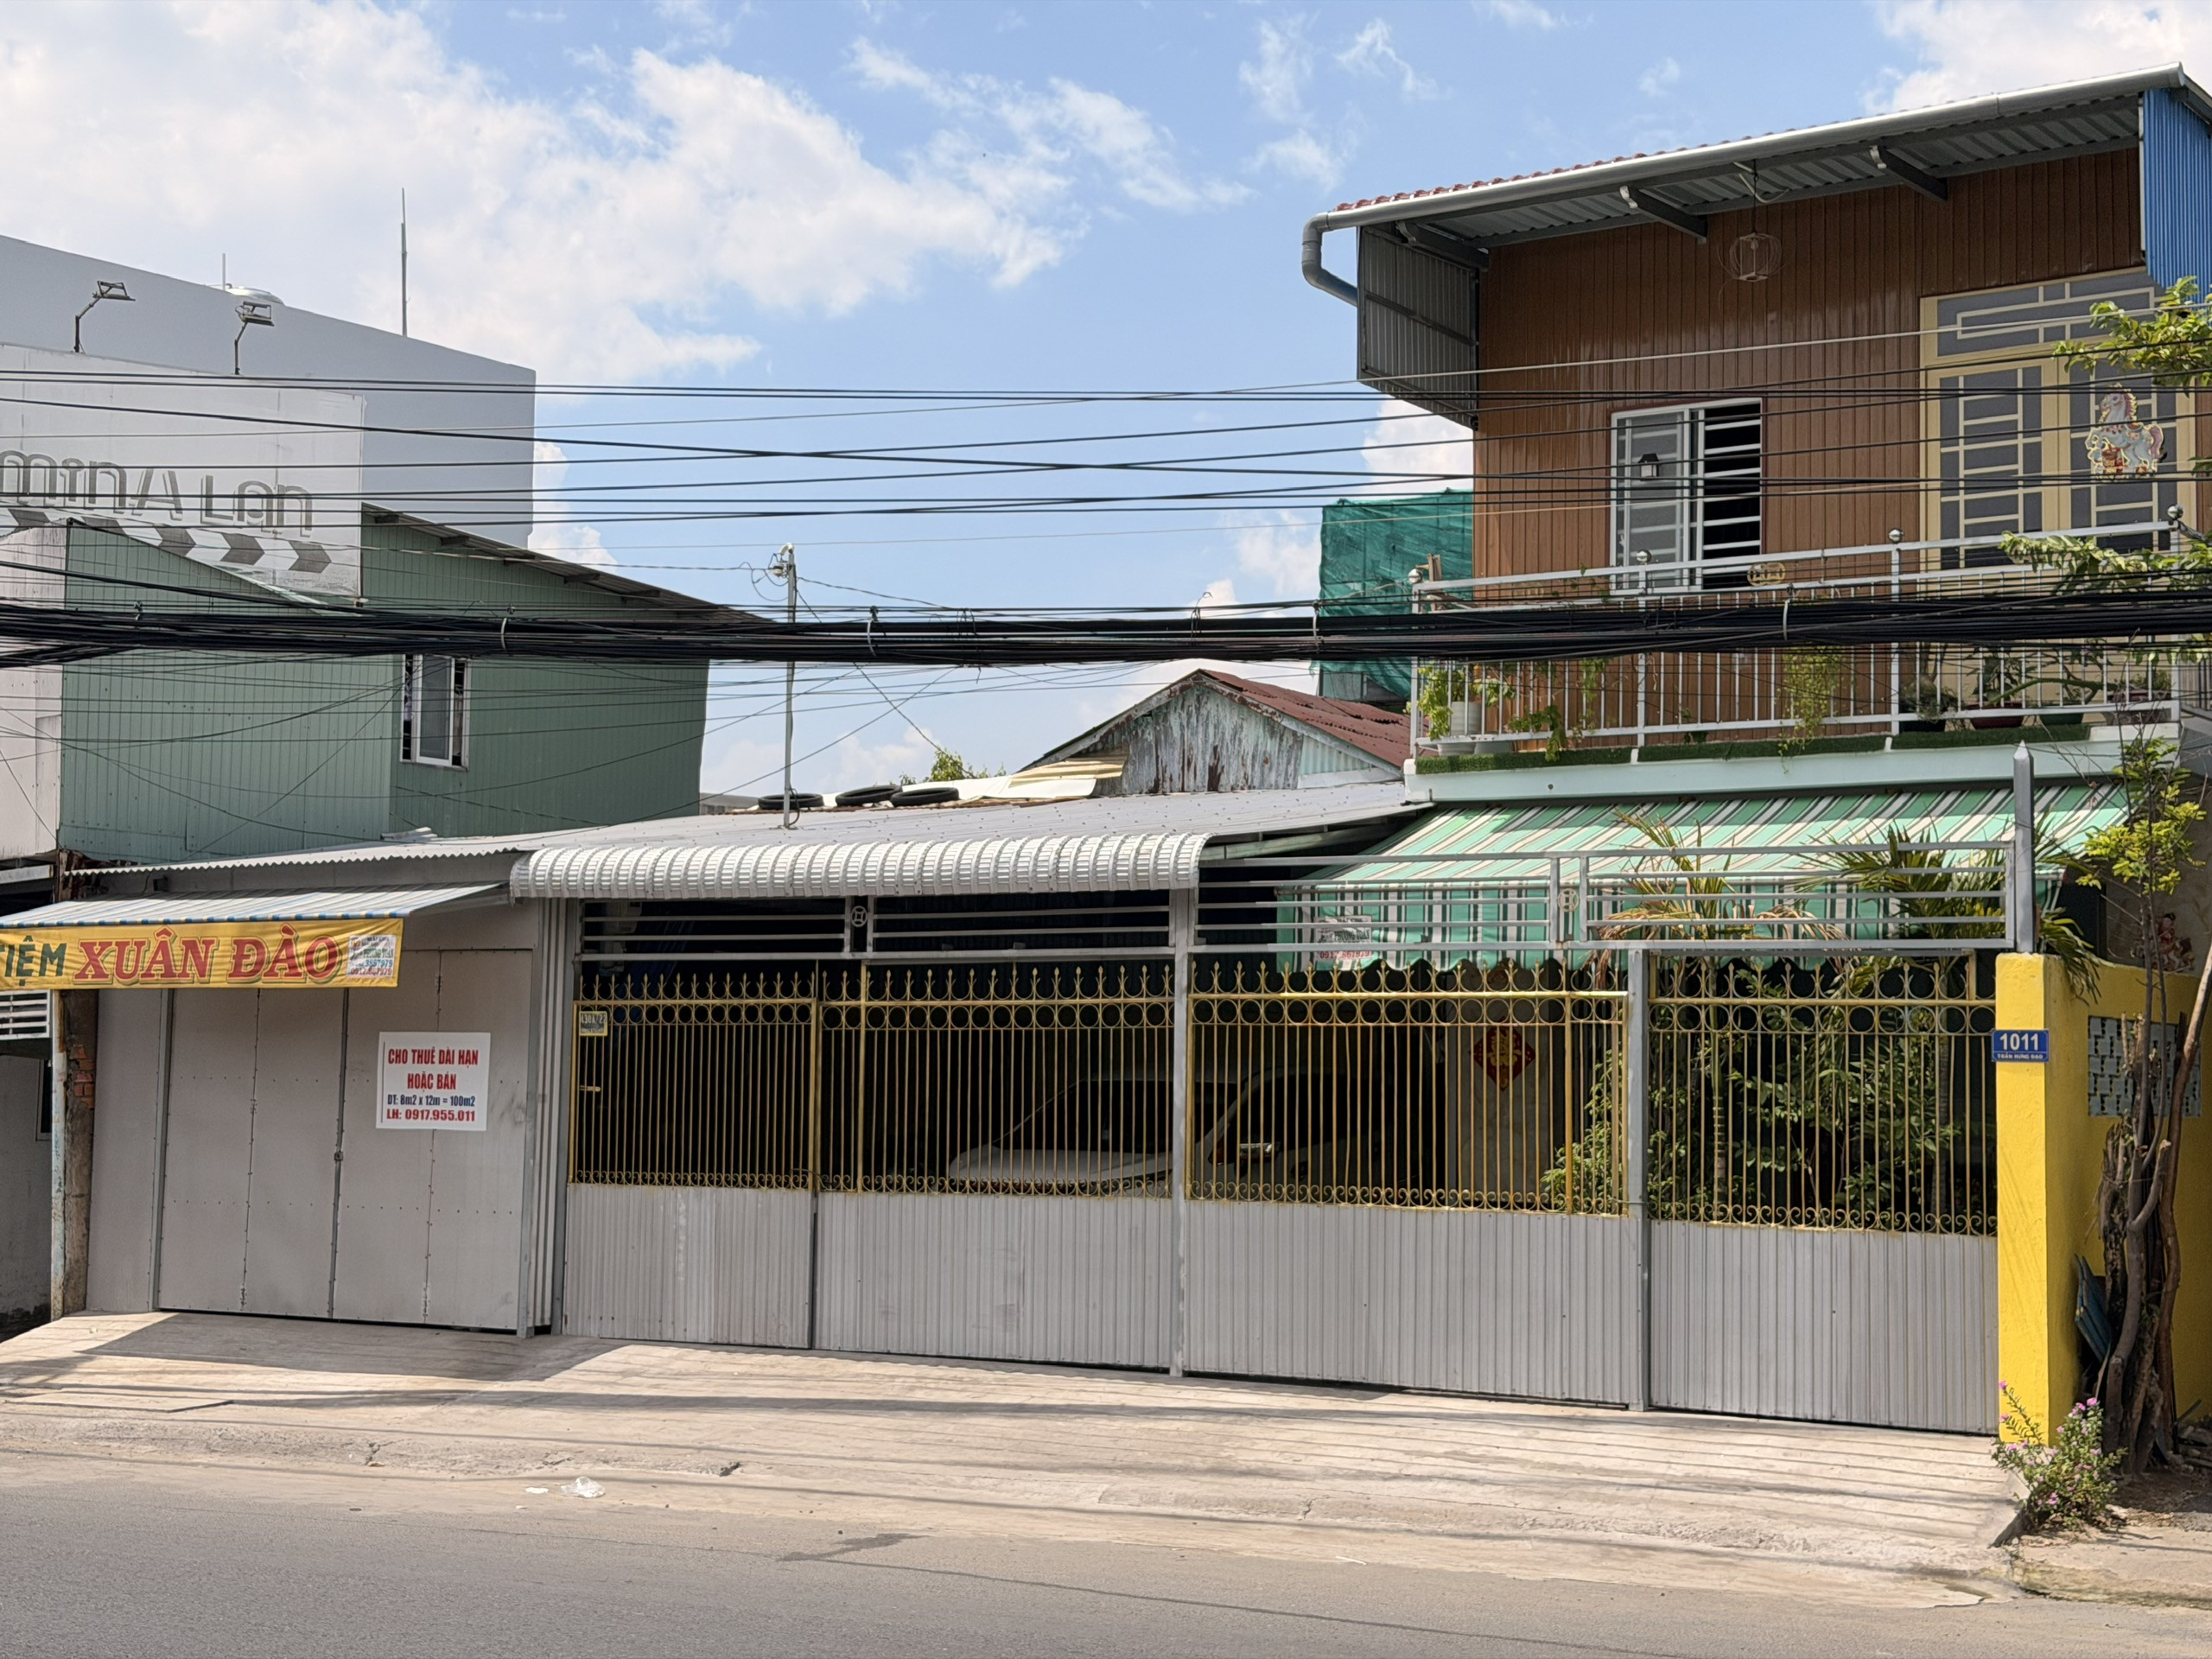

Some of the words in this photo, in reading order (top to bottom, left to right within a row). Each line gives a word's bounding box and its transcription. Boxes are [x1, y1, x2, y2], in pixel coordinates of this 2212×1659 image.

[0, 935, 67, 986] IỆM
[73, 925, 219, 985] XUÂN
[226, 923, 342, 983] ĐÀO
[1999, 1033, 2038, 1051] 1011
[388, 1048, 409, 1065] CHO
[411, 1046, 435, 1065] THUÊ
[438, 1046, 455, 1065] DÀI
[458, 1049, 479, 1069] HẠN
[407, 1071, 434, 1093] HOẶC
[436, 1071, 457, 1090] BÁN
[400, 1094, 417, 1106] 8m2
[418, 1096, 423, 1106] x
[425, 1095, 441, 1106] 12m
[449, 1095, 476, 1107] 100m2
[386, 1108, 403, 1120] LH:
[404, 1109, 476, 1122] 0917.955.011
